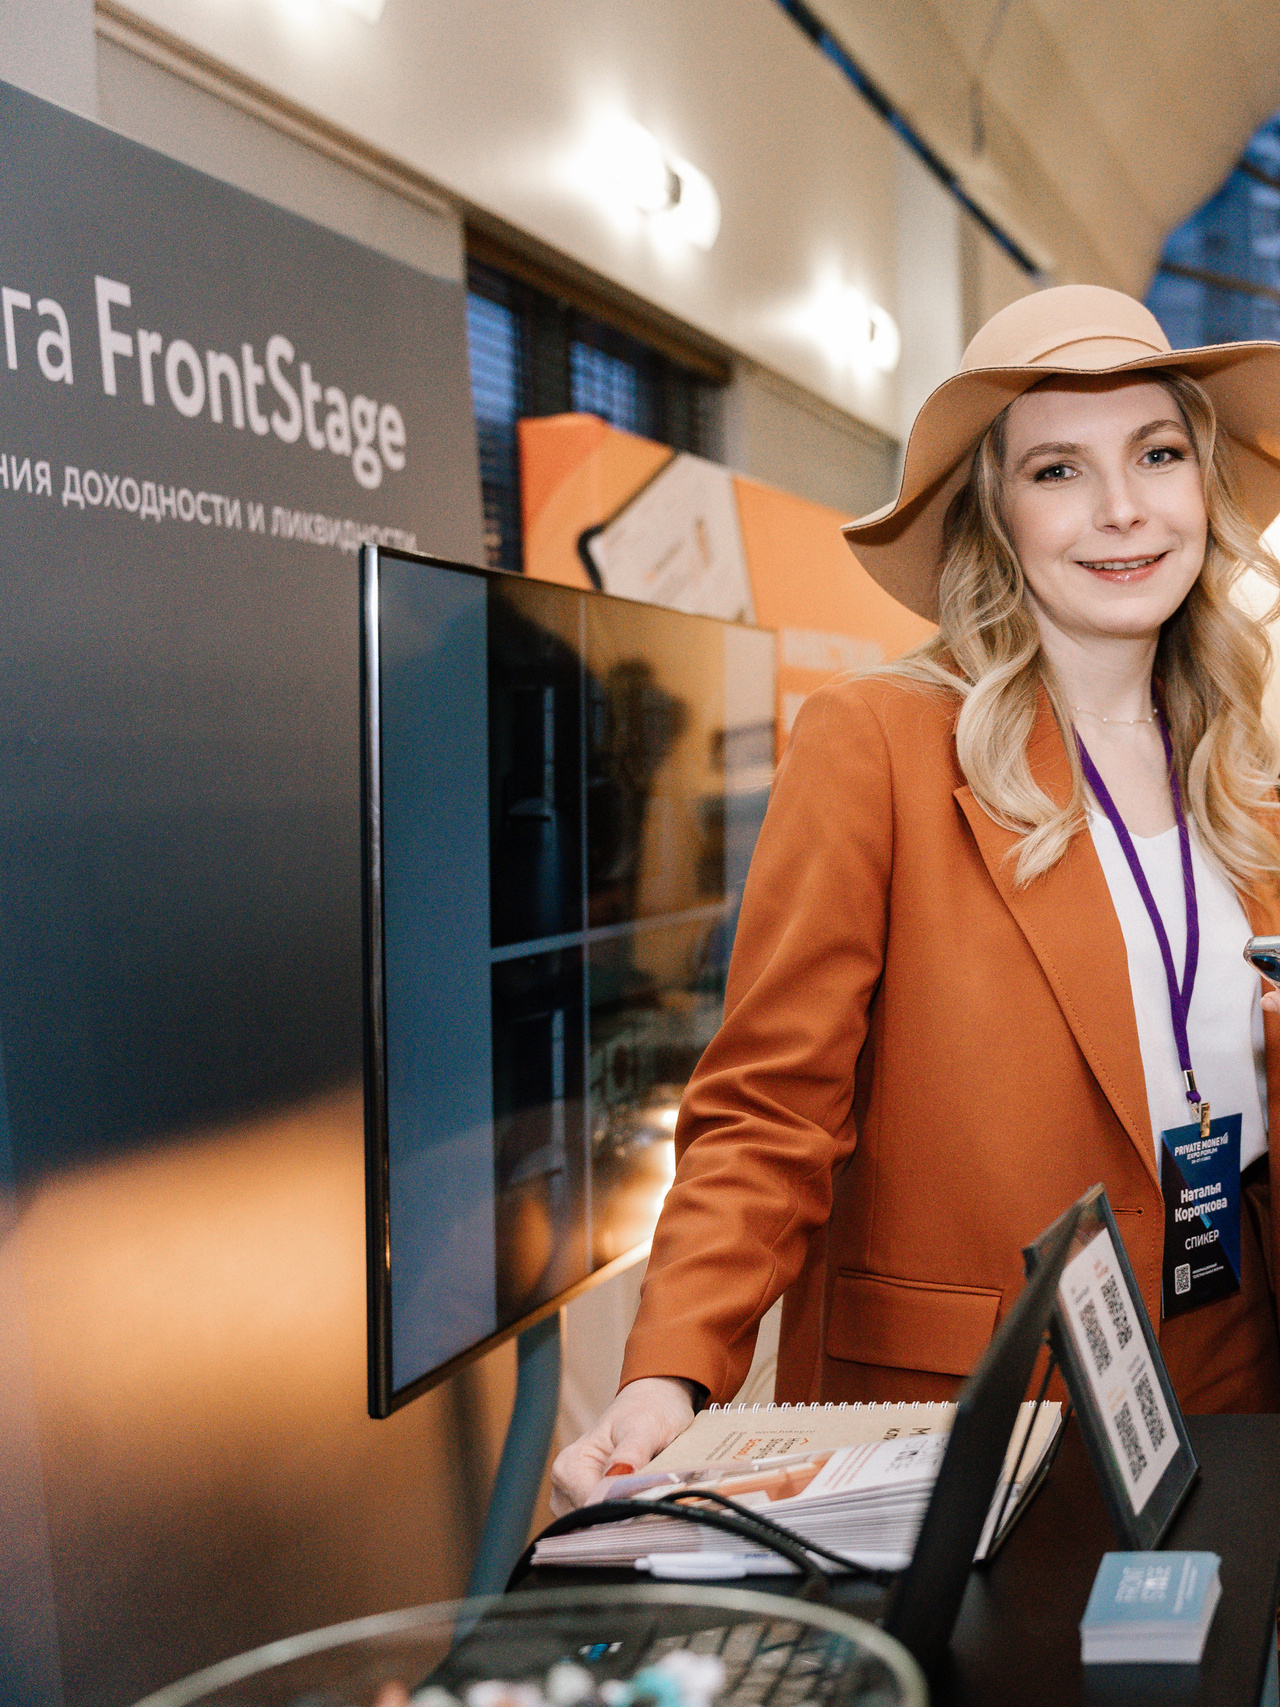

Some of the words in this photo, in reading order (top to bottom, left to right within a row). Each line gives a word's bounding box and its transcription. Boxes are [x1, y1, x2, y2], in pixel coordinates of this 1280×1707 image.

[94, 275, 406, 489] FrontStage
[62, 465, 242, 529] доходности
[247, 501, 265, 534] и
[1174, 1141, 1201, 1156] PRIVATE
[1202, 1132, 1228, 1150] MONEY
[1180, 1182, 1222, 1203] Наталья
[1174, 1197, 1228, 1222] Короткова
[1184, 1229, 1220, 1250] СПИКЕР
